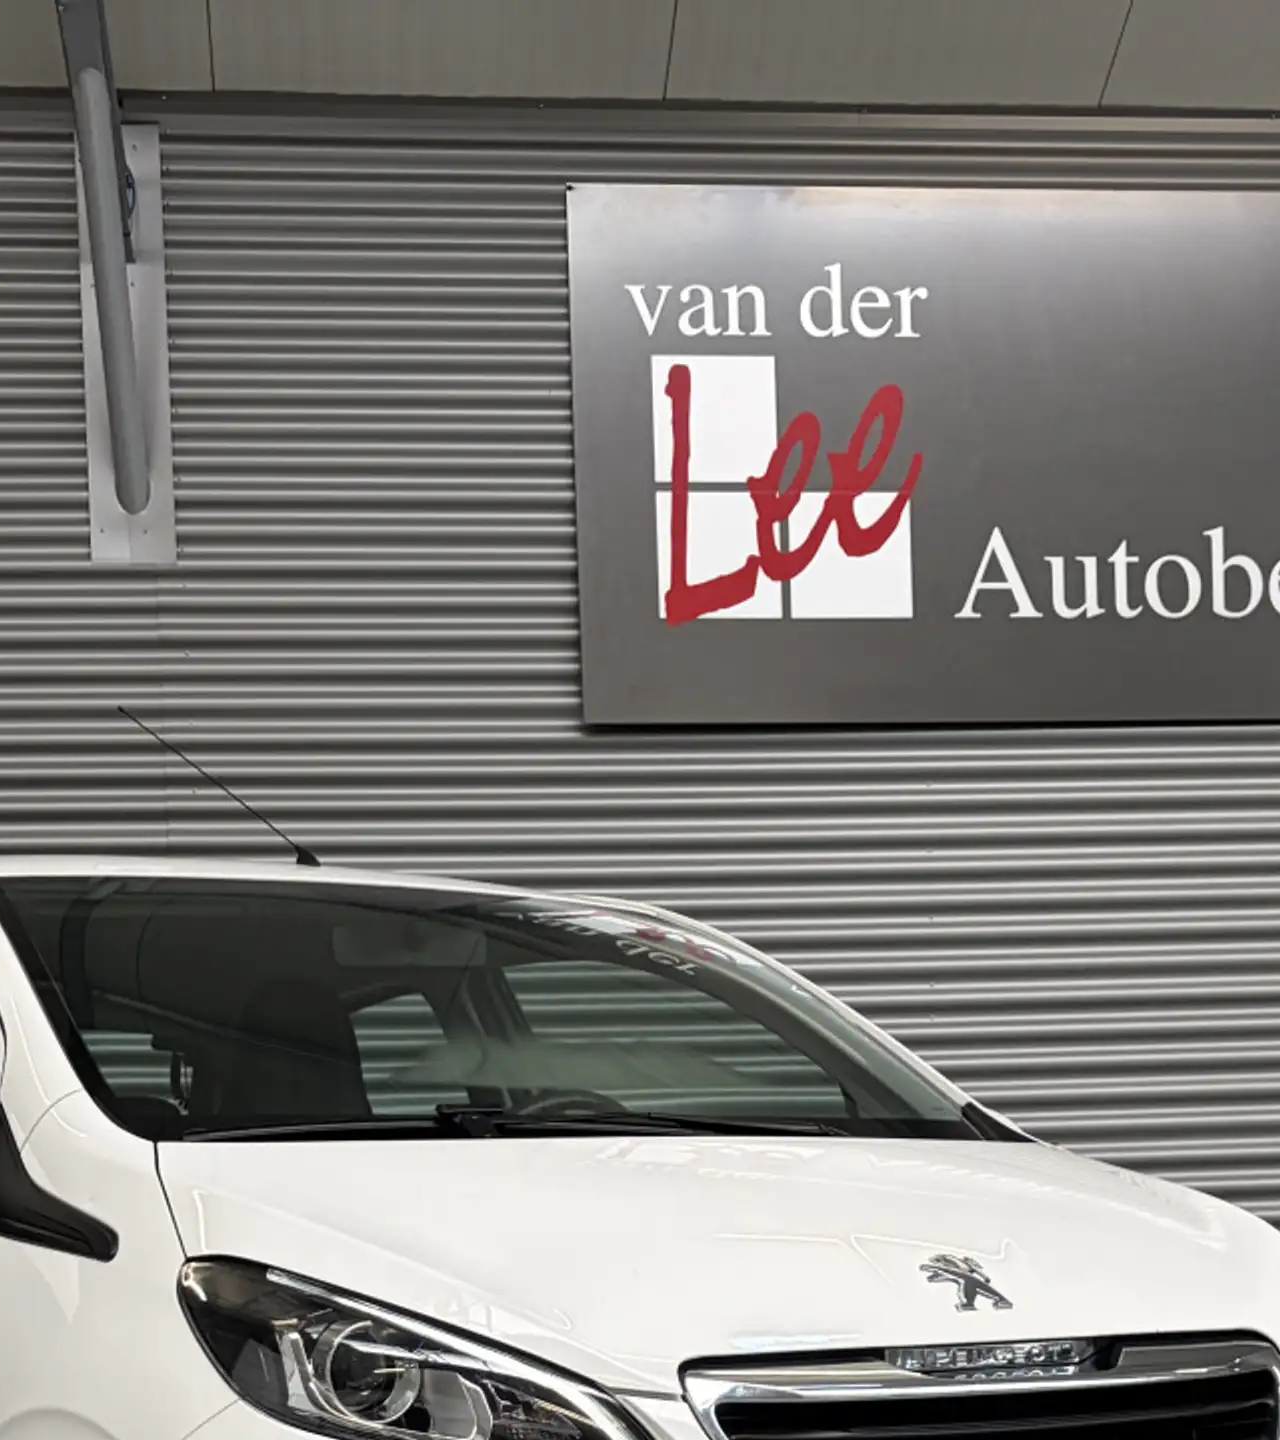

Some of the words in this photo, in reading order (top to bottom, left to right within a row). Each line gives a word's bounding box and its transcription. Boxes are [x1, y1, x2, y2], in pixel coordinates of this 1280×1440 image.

[624, 284, 772, 337] van
[799, 262, 929, 338] der
[664, 363, 924, 627] Lee
